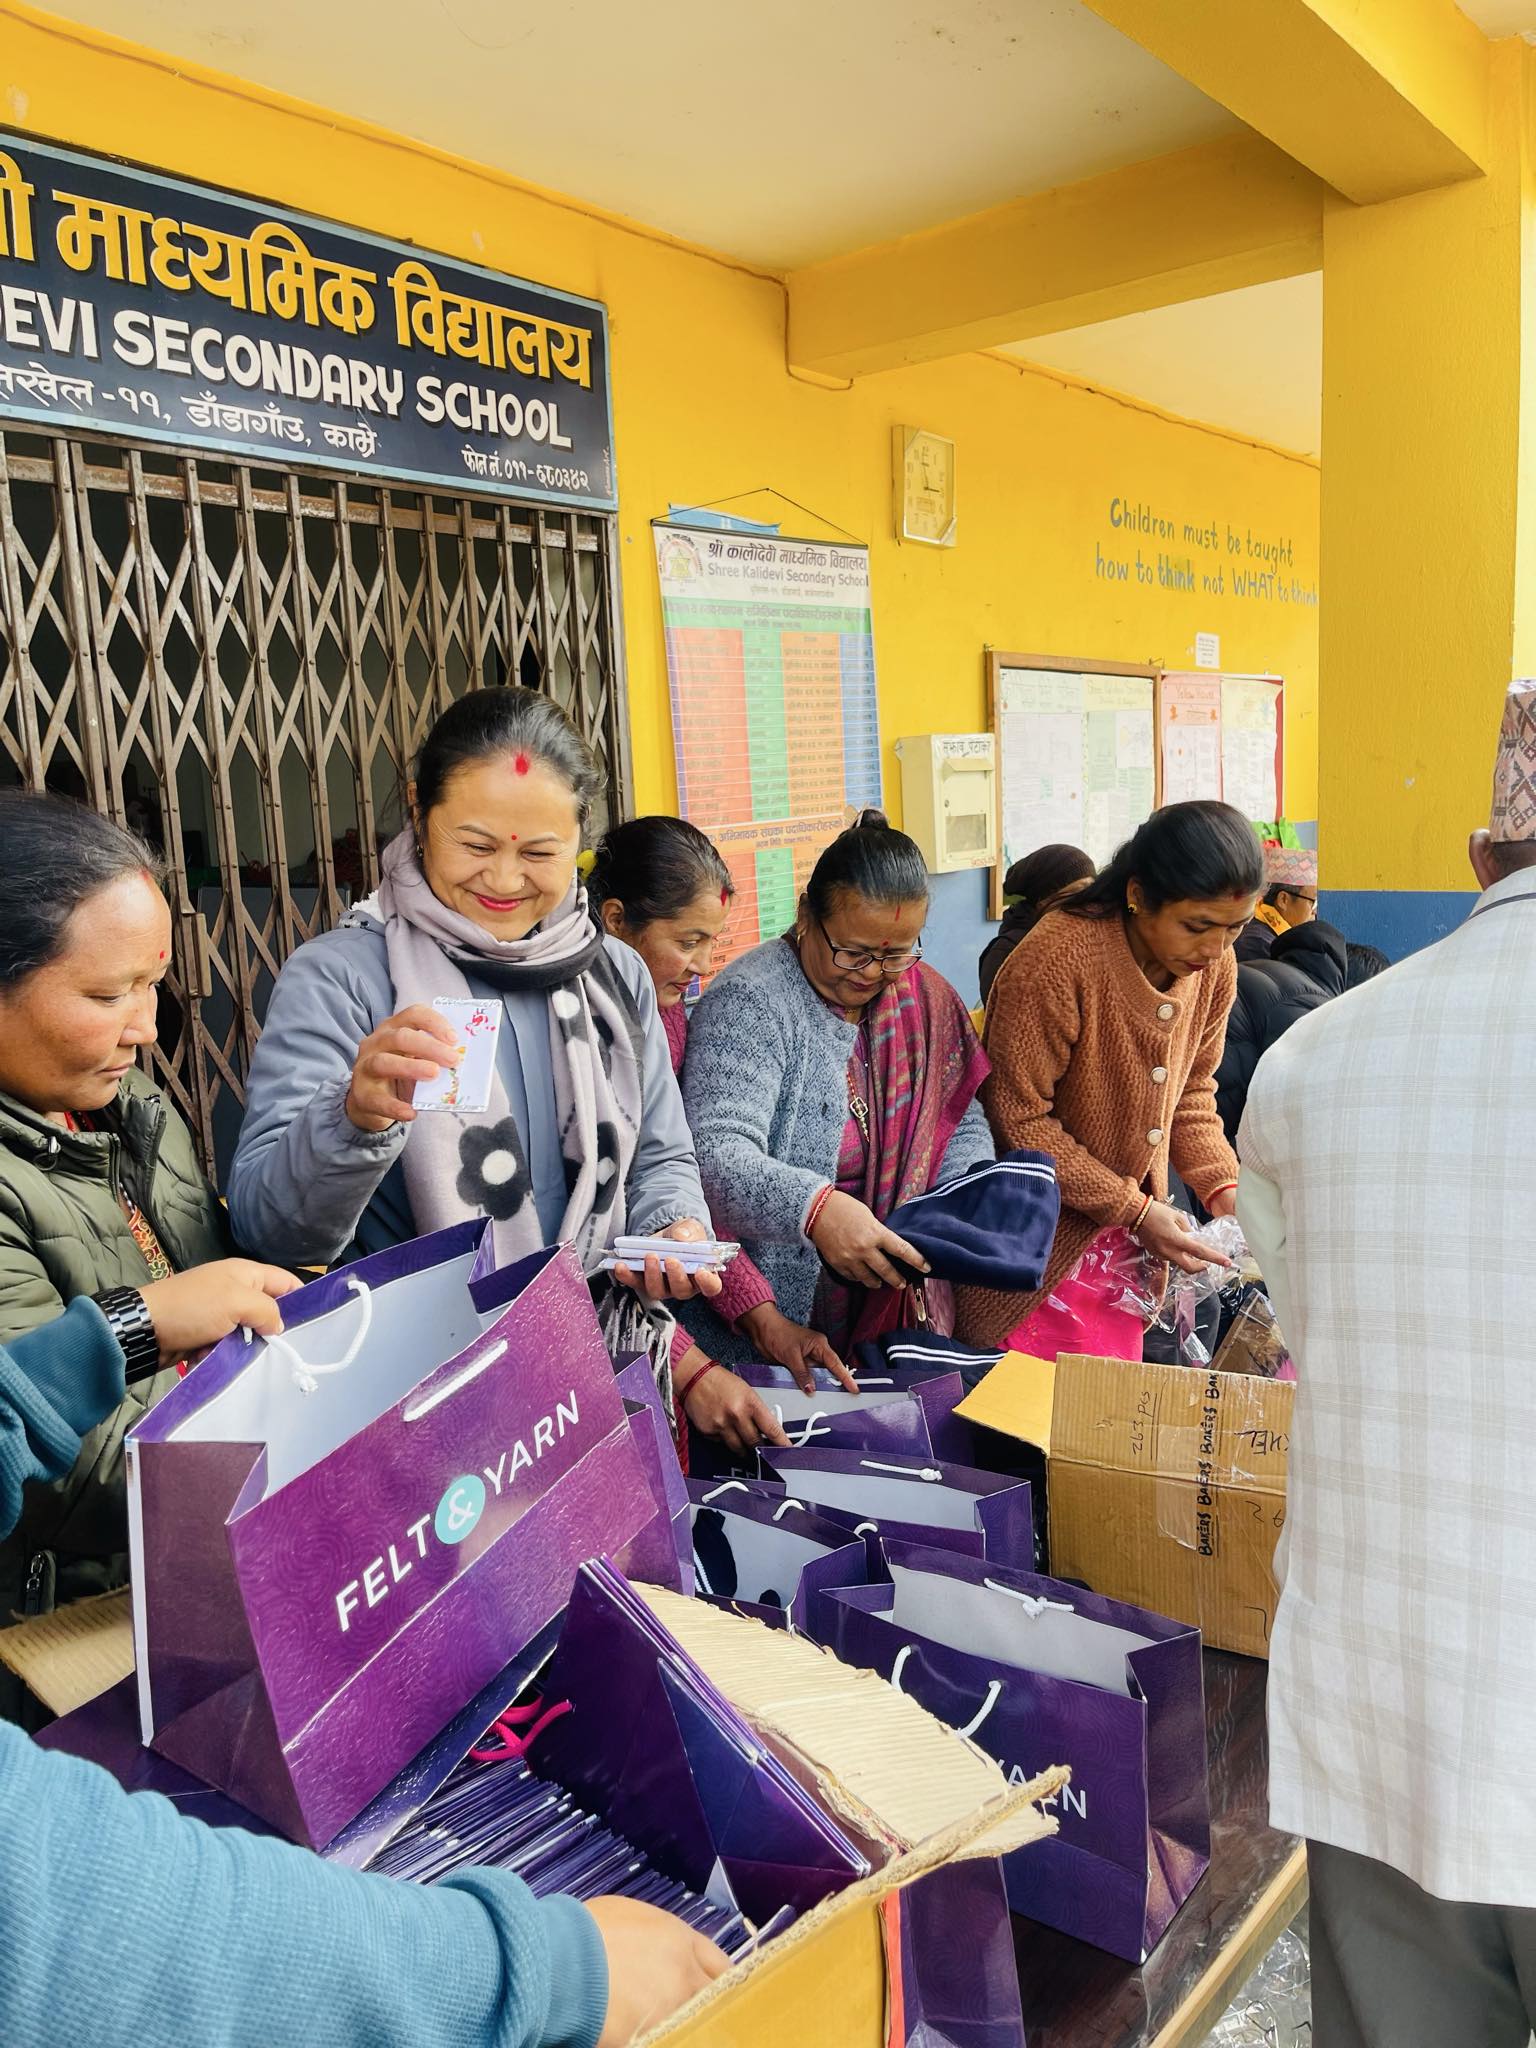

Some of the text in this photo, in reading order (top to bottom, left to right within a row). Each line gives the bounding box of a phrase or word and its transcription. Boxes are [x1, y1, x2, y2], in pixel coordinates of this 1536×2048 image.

[52, 189, 377, 335] माध्यमिक
[388, 261, 593, 389] विद्यालय
[0, 284, 573, 449] EVI SECONDARY SCHOOL
[708, 540, 723, 558] श्री
[727, 542, 776, 563] कालीदेवी
[779, 547, 828, 567] माध्यमिक
[1110, 498, 1293, 575] Children must be taught
[708, 562, 869, 588] Shree Kalidevi Secondary School
[1096, 541, 1128, 581] how
[1136, 550, 1153, 584] to
[1158, 553, 1196, 593] think
[1203, 565, 1224, 596] not
[1232, 568, 1274, 601] WHAT
[1277, 576, 1289, 603] to
[1130, 1420, 1144, 1455] 263
[335, 1513, 431, 1632] FELT
[483, 1389, 580, 1495] YARN
